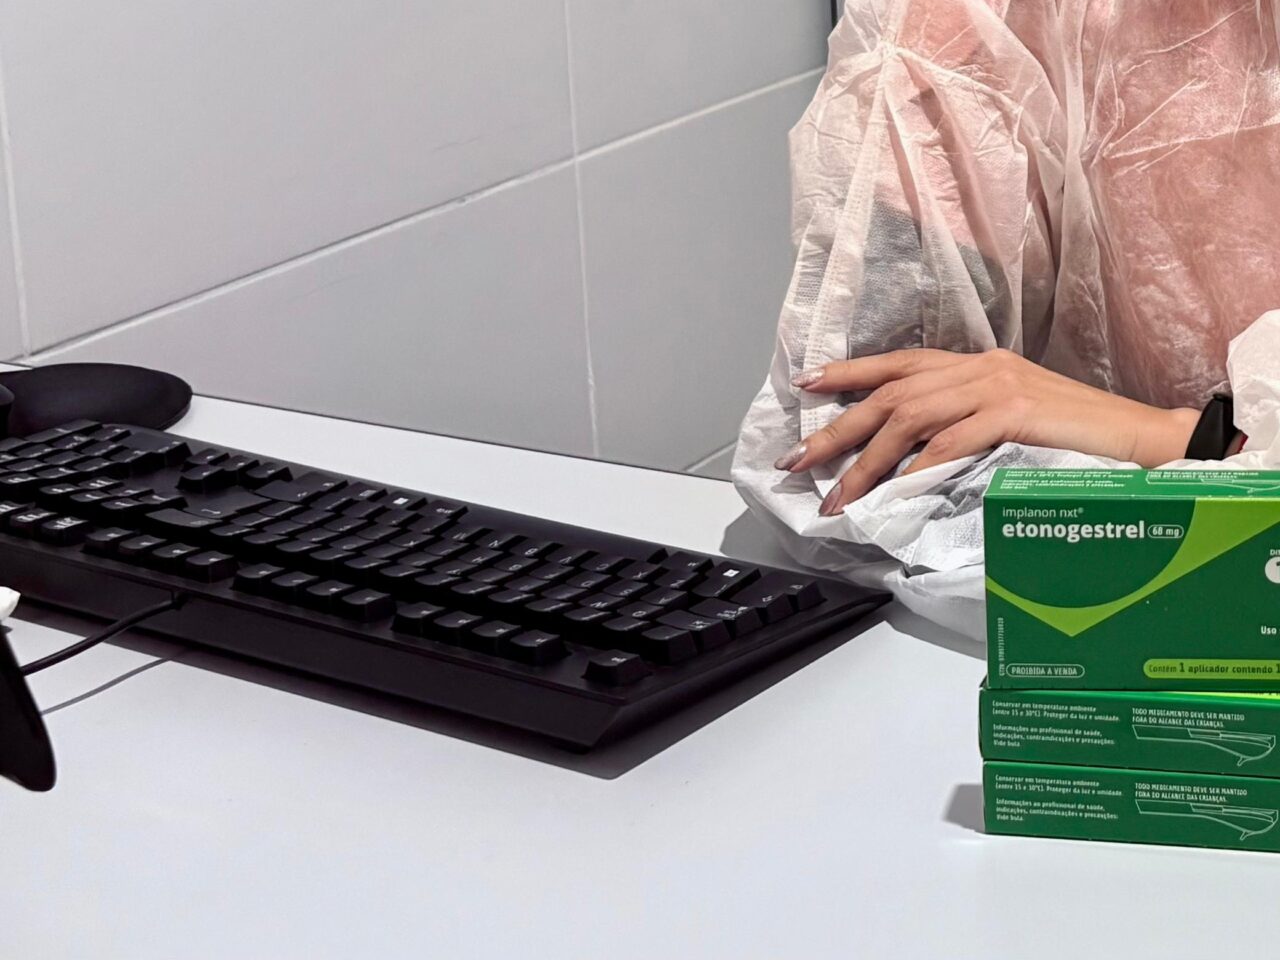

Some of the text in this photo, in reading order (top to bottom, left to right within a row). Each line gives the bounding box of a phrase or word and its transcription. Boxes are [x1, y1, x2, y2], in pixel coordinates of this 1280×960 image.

[1002, 507, 1056, 519] implanon
[1002, 520, 1180, 542] etonogestrel 68 mg
[1261, 626, 1276, 635] Uso
[1011, 666, 1078, 676] PROIBIDA A VENDA
[1149, 664, 1176, 672] Contém
[1179, 662, 1186, 672] 1
[1188, 664, 1229, 676] aplicador
[1232, 665, 1273, 674] contendo
